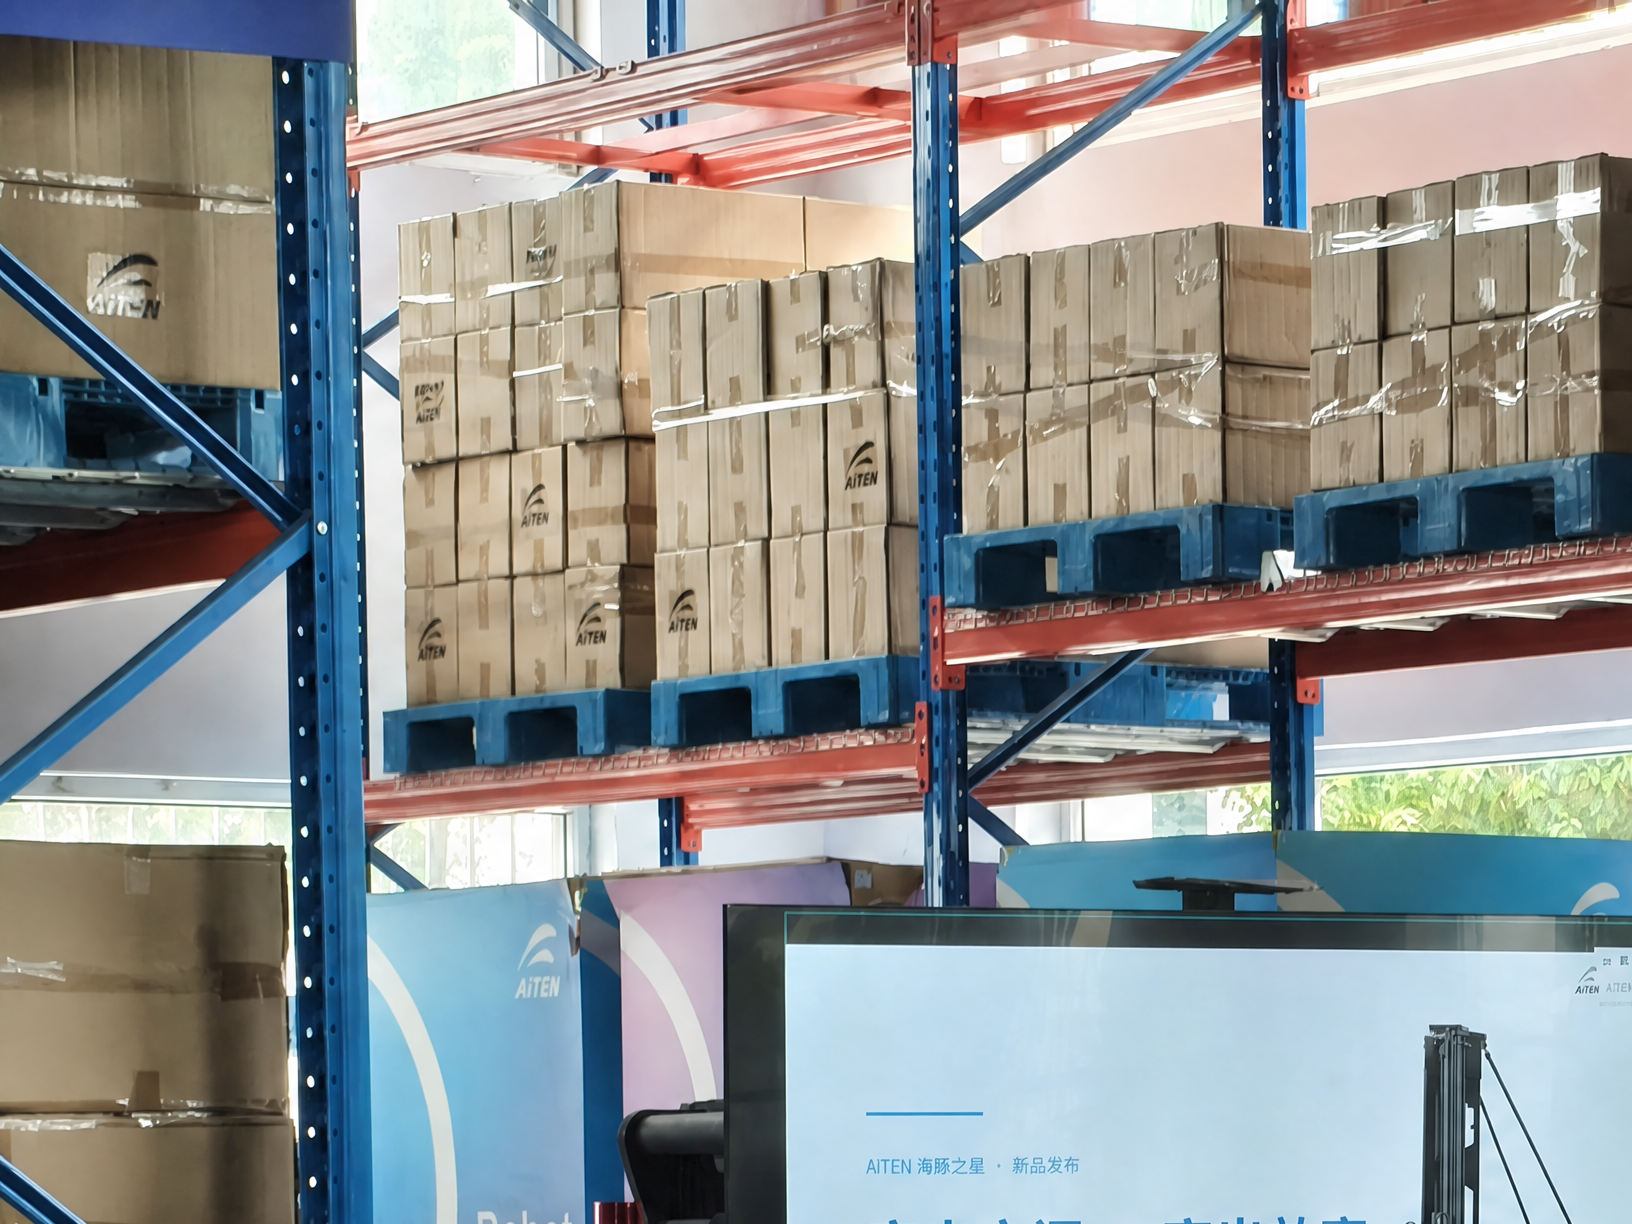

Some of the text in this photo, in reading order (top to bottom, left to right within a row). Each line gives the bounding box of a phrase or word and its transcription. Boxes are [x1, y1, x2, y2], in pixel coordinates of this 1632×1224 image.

[845, 471, 878, 490] AiTEN
[668, 617, 698, 633] AiTEN
[514, 975, 561, 999] AiTEN
[917, 1157, 985, 1175] 海豚之星
[1012, 1156, 1080, 1174] 新品发布
